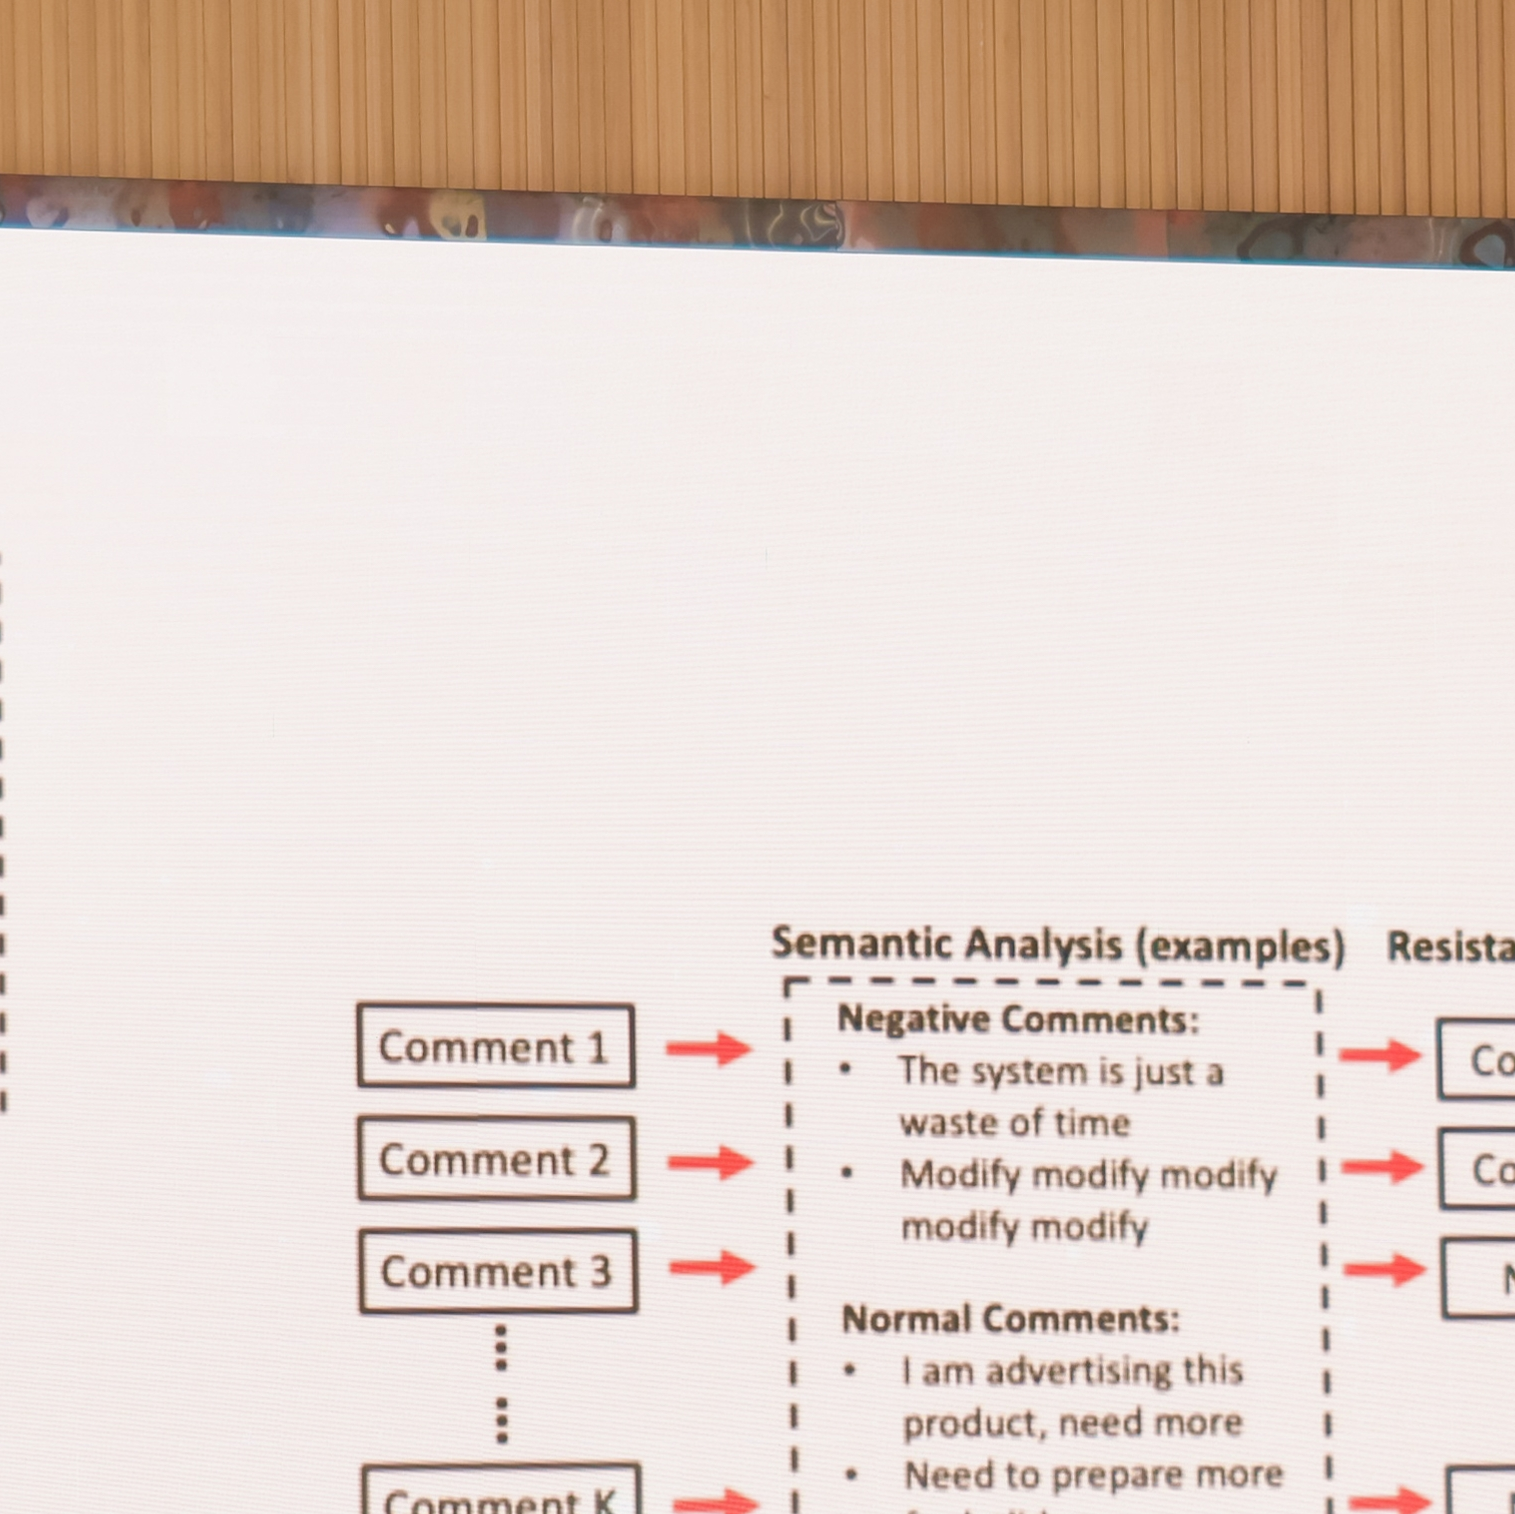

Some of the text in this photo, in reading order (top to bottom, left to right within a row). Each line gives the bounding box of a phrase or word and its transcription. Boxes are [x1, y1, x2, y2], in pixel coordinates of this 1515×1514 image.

[772, 923, 1346, 971] Semantic Analysis (examples)
[837, 1002, 1199, 1040] Negative Comments:
[378, 1028, 609, 1065] Comment 1
[896, 1053, 1225, 1093] The system is just a
[899, 1105, 1131, 1139] waste of time
[378, 1141, 610, 1178] Comment 2
[901, 1157, 1278, 1197] Modify modify modify
[902, 1208, 1149, 1249] modify modify
[380, 1253, 613, 1290] Comment 3
[842, 1302, 1180, 1335] Normal Comments:
[903, 1353, 1245, 1393] I am advertising this
[903, 1405, 1244, 1446] product, need more
[905, 1458, 1285, 1497] Need to prepare more
